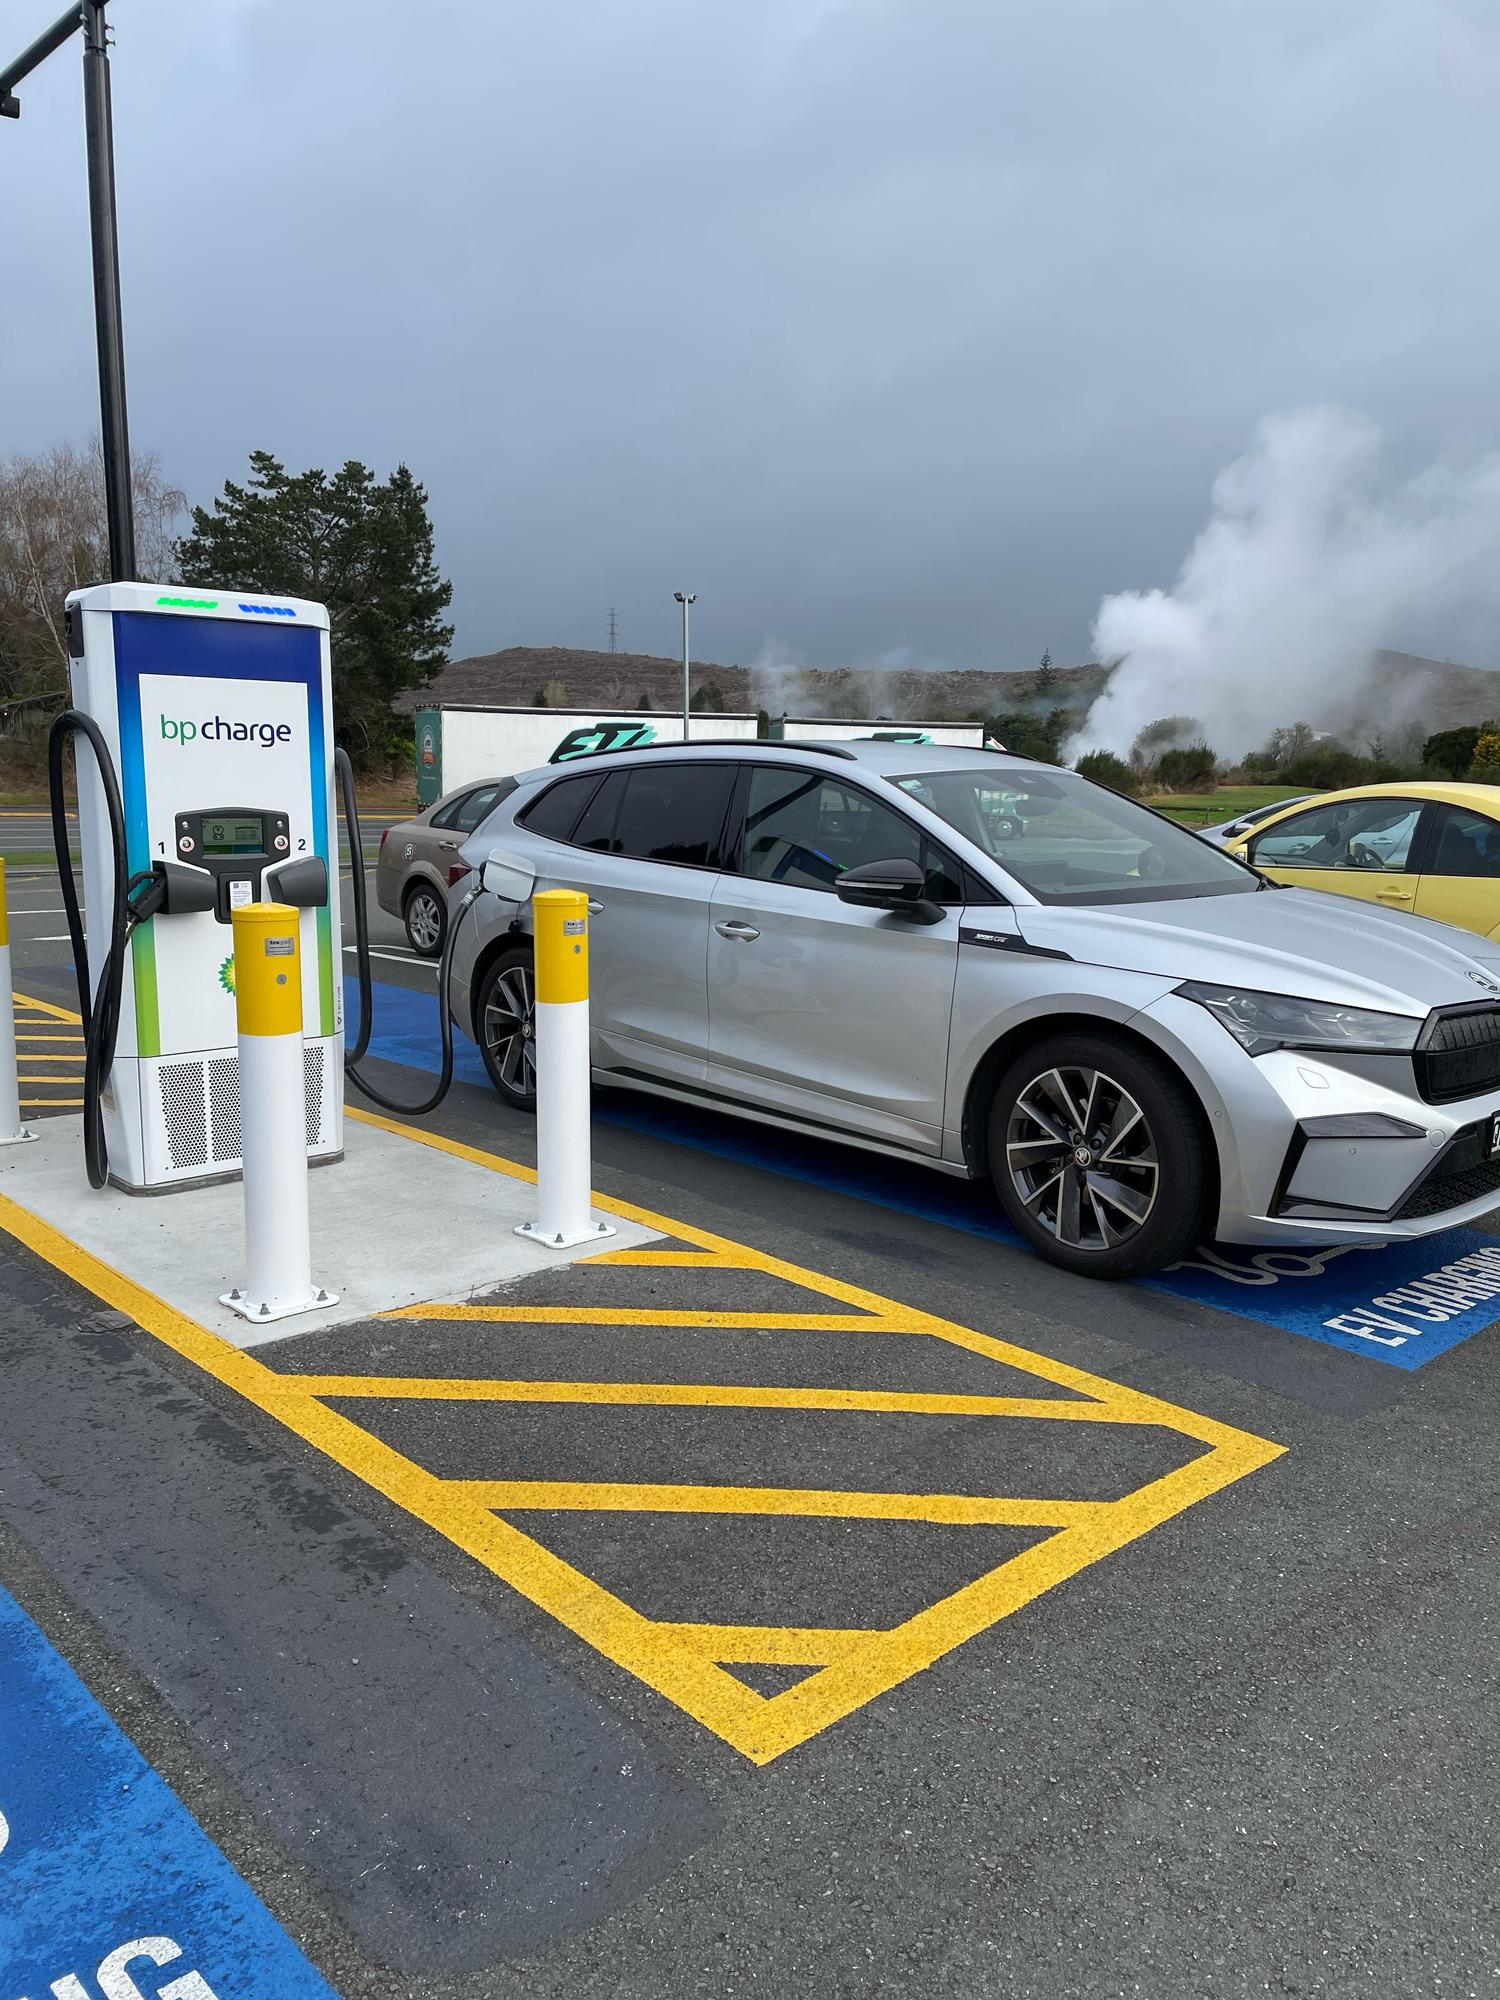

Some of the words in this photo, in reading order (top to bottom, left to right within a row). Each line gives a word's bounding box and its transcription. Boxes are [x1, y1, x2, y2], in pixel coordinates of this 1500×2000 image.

[160, 714, 197, 745] bp
[201, 716, 292, 747] charge
[157, 841, 166, 855] 1
[297, 839, 307, 851] 2
[1322, 1307, 1423, 1347] EV
